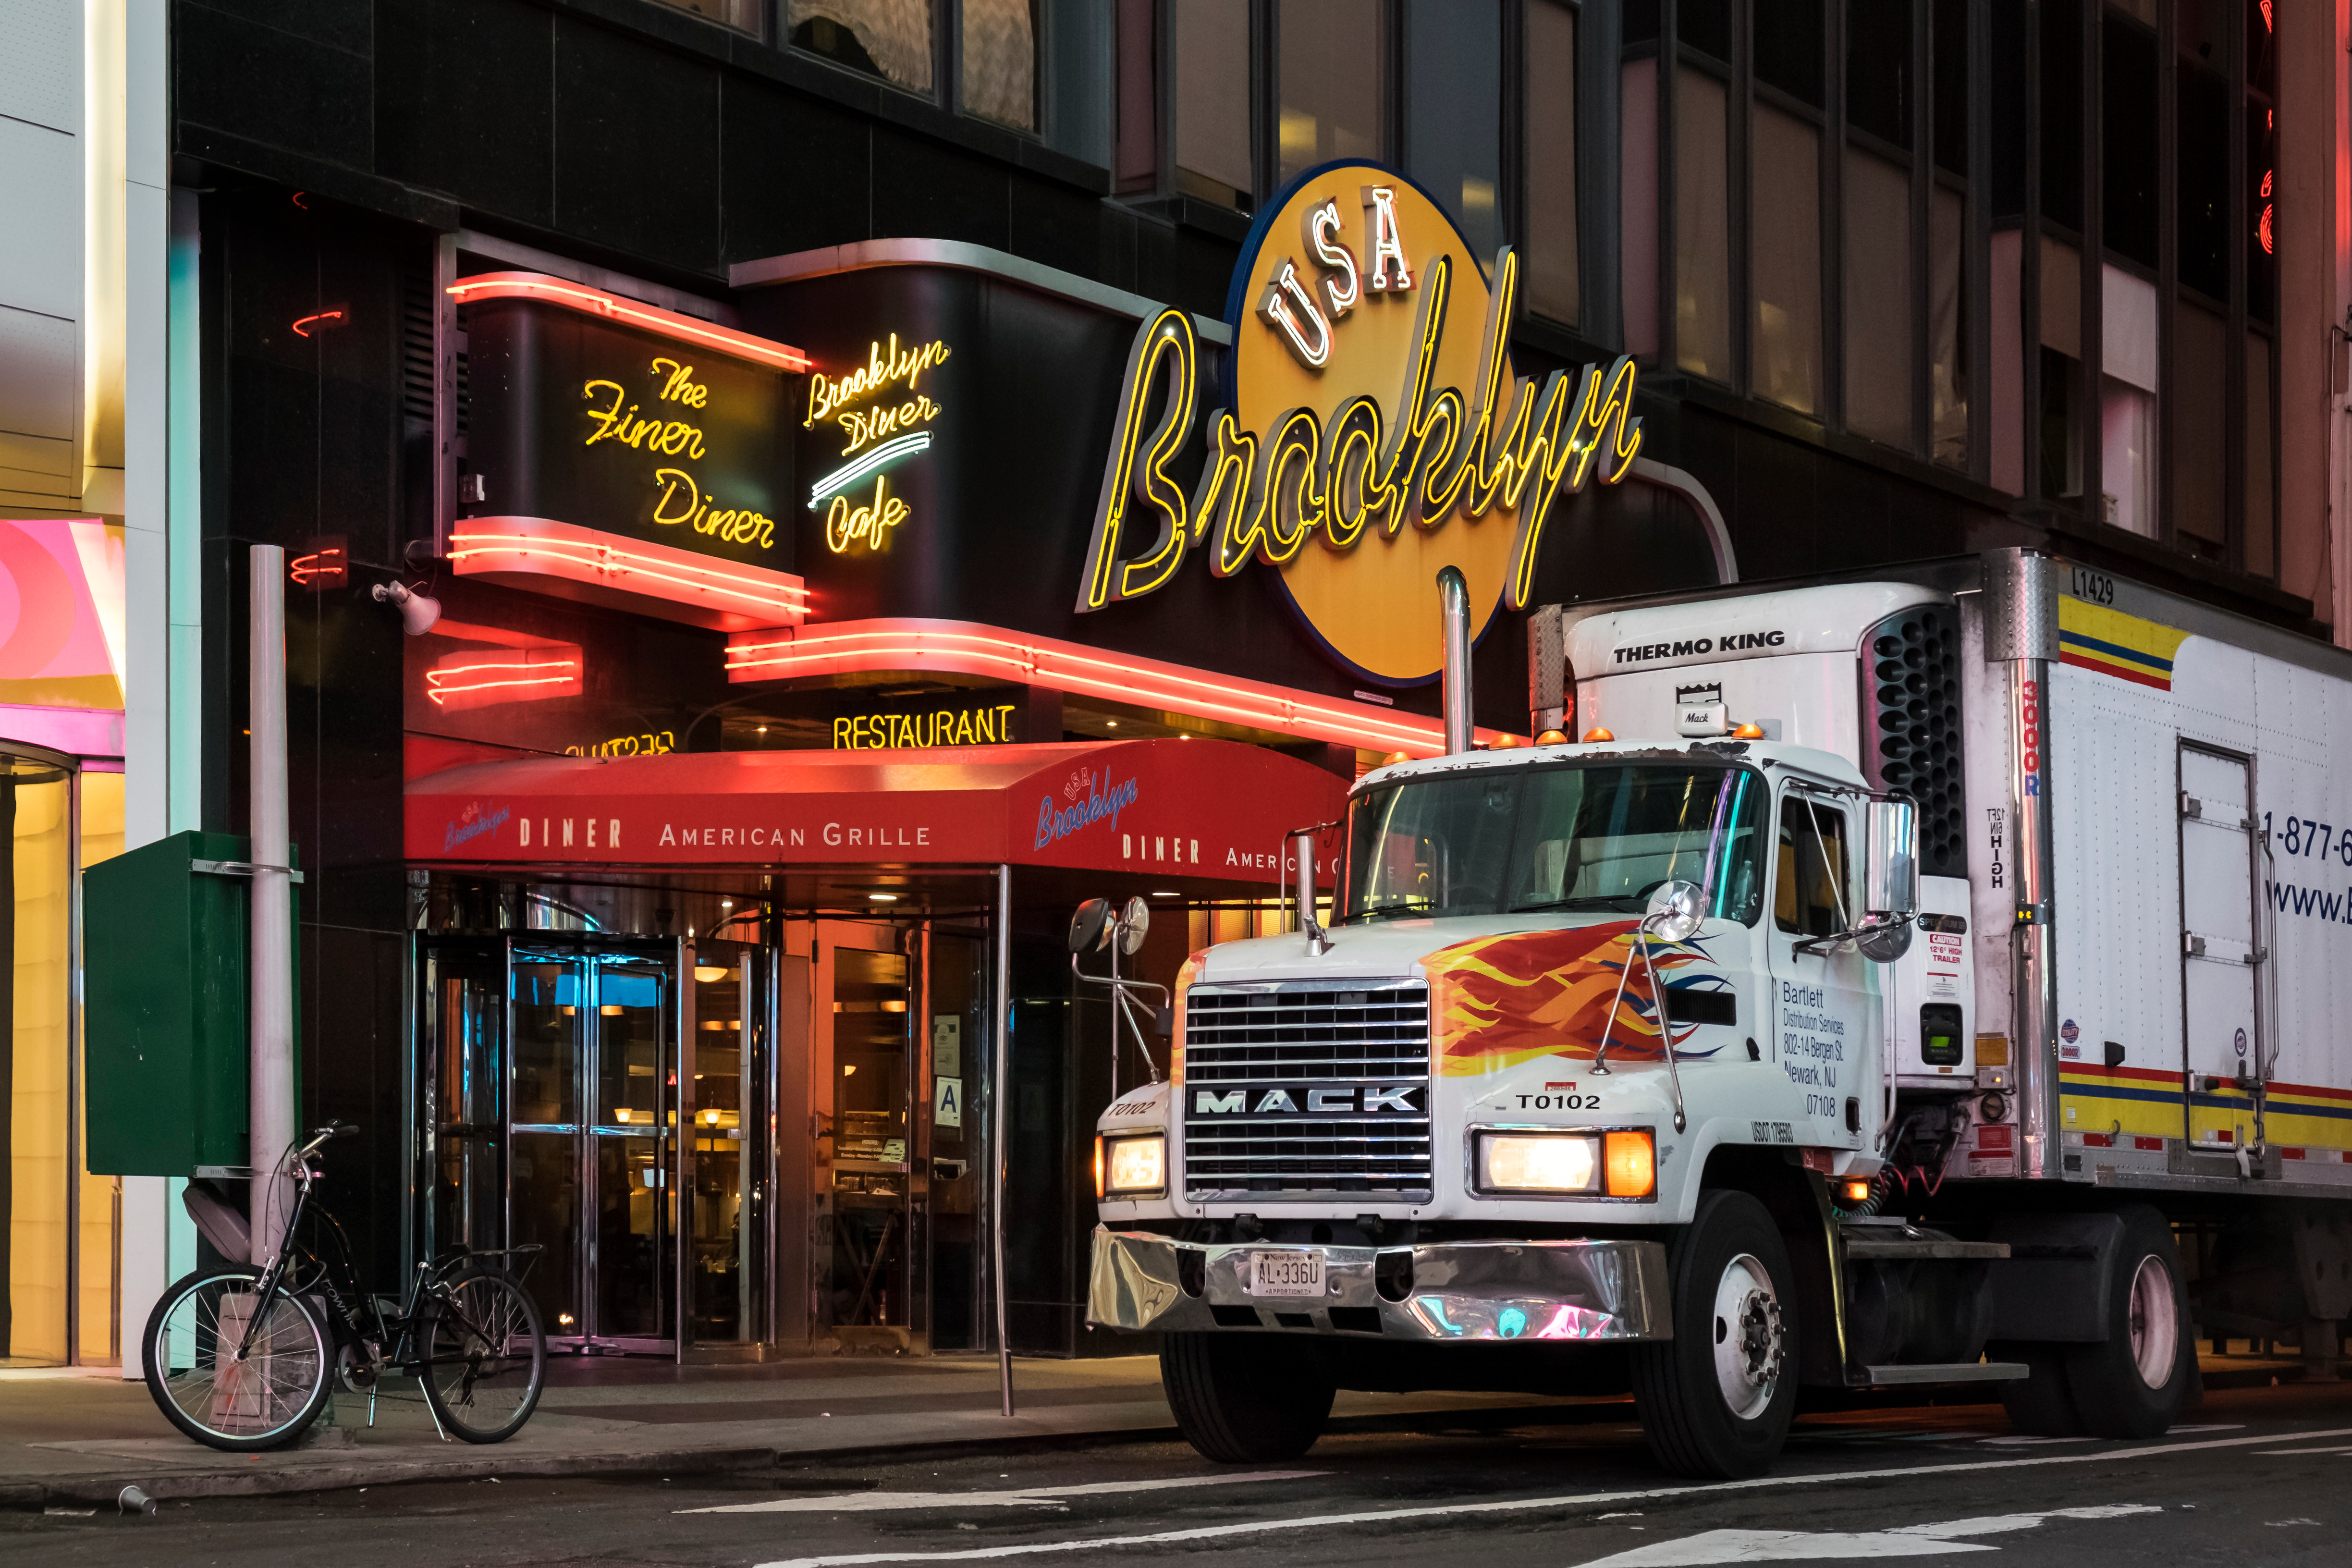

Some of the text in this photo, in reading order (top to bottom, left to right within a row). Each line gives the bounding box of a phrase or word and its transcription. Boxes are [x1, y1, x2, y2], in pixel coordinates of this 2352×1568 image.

[1256, 184, 1417, 369] USA
[652, 357, 707, 408] The
[803, 333, 949, 427] Brooklyn
[585, 380, 705, 460] Finer
[838, 395, 938, 456] Diner
[1075, 245, 1644, 613] Brooklyn
[654, 468, 774, 548] Diner
[827, 475, 907, 553] Cafe
[2072, 567, 2114, 605] L1429
[1614, 630, 1785, 663] THERMO KING
[834, 706, 1015, 749] RESTAURANT
[1685, 713, 1709, 723] Mack
[1064, 767, 1090, 800] USA
[462, 802, 479, 822] USA
[1034, 765, 1138, 851] Brooklyn
[444, 799, 510, 853] Brooklyn
[519, 818, 620, 848] DINER
[659, 822, 930, 846] AMERICAN GRILLE
[1123, 834, 1199, 864] DINER
[1226, 847, 1321, 873] AMERCN
[1932, 935, 1960, 945] CAUTION
[1933, 955, 1960, 964] TRAILER
[1783, 981, 1824, 1009] Bartlett
[1784, 1008, 1844, 1035] Distribution Services
[1784, 1033, 1844, 1064] 802-14 Bergen St.
[1785, 1060, 1836, 1089] Newark, NJ
[940, 1085, 956, 1113] A
[1108, 1101, 1156, 1116] T0102
[1196, 1088, 1418, 1113] MACK
[1516, 1095, 1600, 1109] T0102
[1807, 1094, 1836, 1117] 07108
[1751, 1122, 1771, 1142] USDOT
[1286, 1254, 1307, 1262] Jersey
[320, 1278, 356, 1330] townie
